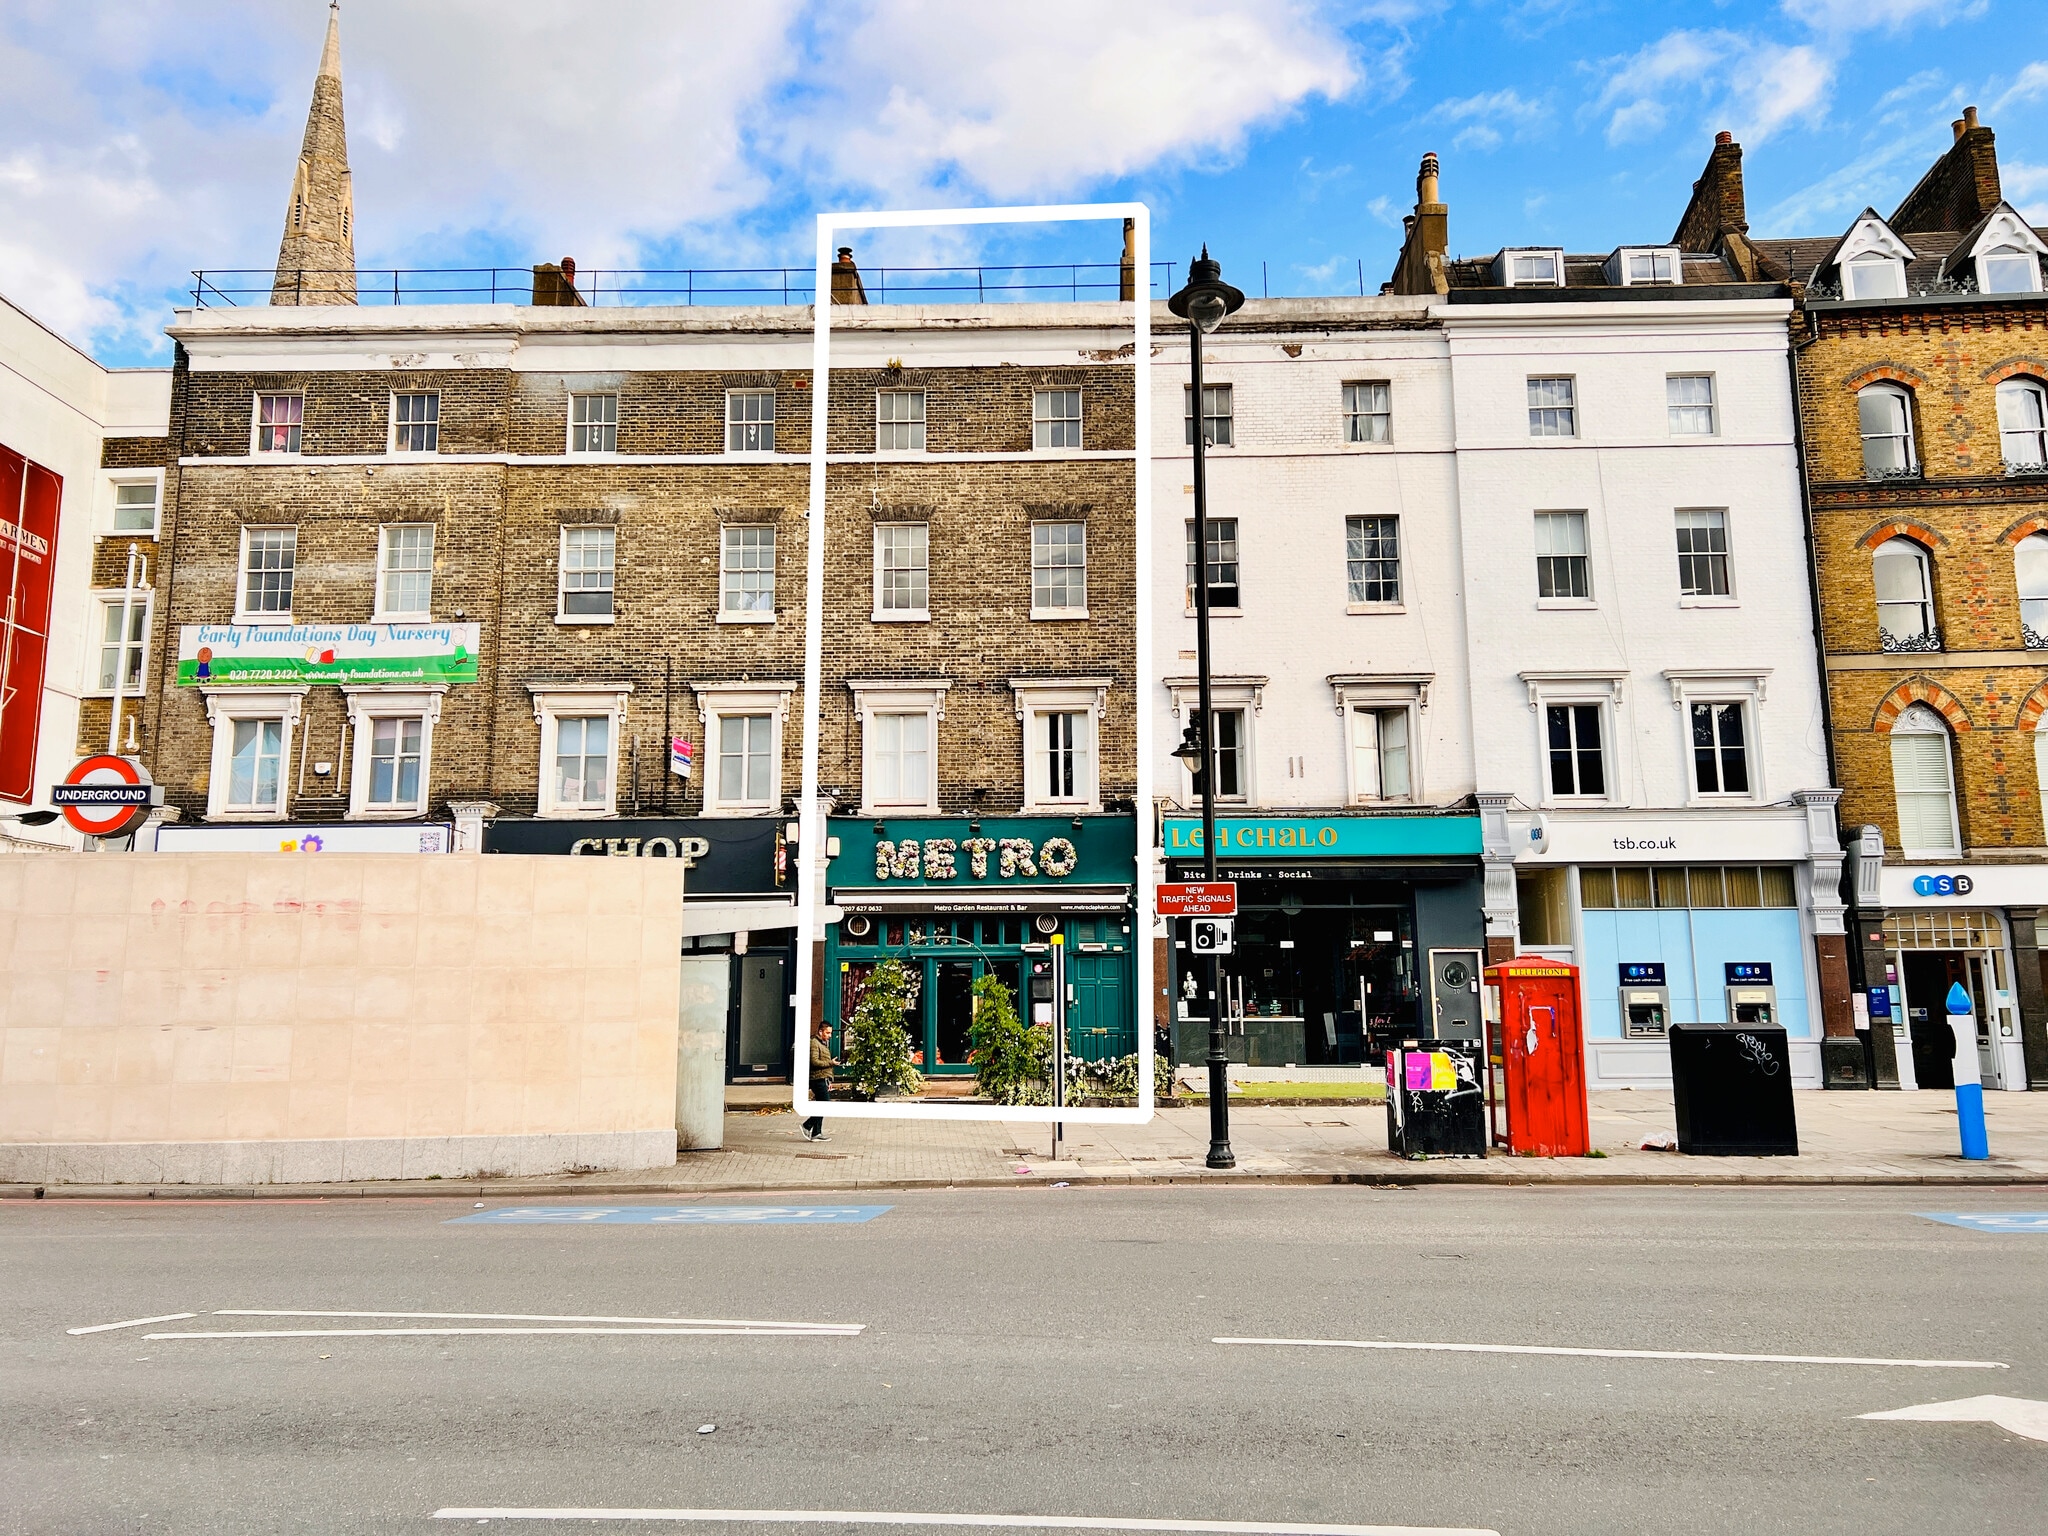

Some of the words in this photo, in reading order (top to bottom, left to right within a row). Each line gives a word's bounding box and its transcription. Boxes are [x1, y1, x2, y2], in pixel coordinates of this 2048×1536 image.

[198, 624, 241, 648] Early
[245, 624, 341, 642] Foundations
[347, 624, 377, 647] Day
[381, 624, 451, 646] Nursery
[229, 670, 247, 680] 020
[249, 669, 272, 680] 7720
[274, 669, 298, 680] 2424
[55, 790, 146, 800] UNDERGROUND
[1613, 836, 1676, 849] tsb.co.uk
[570, 837, 710, 868] CHOP
[875, 837, 1078, 880] METRO
[1183, 871, 1206, 879] Bite
[1228, 871, 1262, 879] Drinks
[1278, 871, 1312, 879] Social
[1185, 886, 1205, 894] NEW
[1919, 877, 1971, 893] TSB
[1161, 895, 1194, 903] TRAFFIC
[1197, 894, 1232, 903] SIGNALS
[759, 968, 766, 979] 8
[1513, 968, 1565, 976] TELEPHONE
[1631, 967, 1654, 975] TSB
[1737, 967, 1760, 975] TSB
